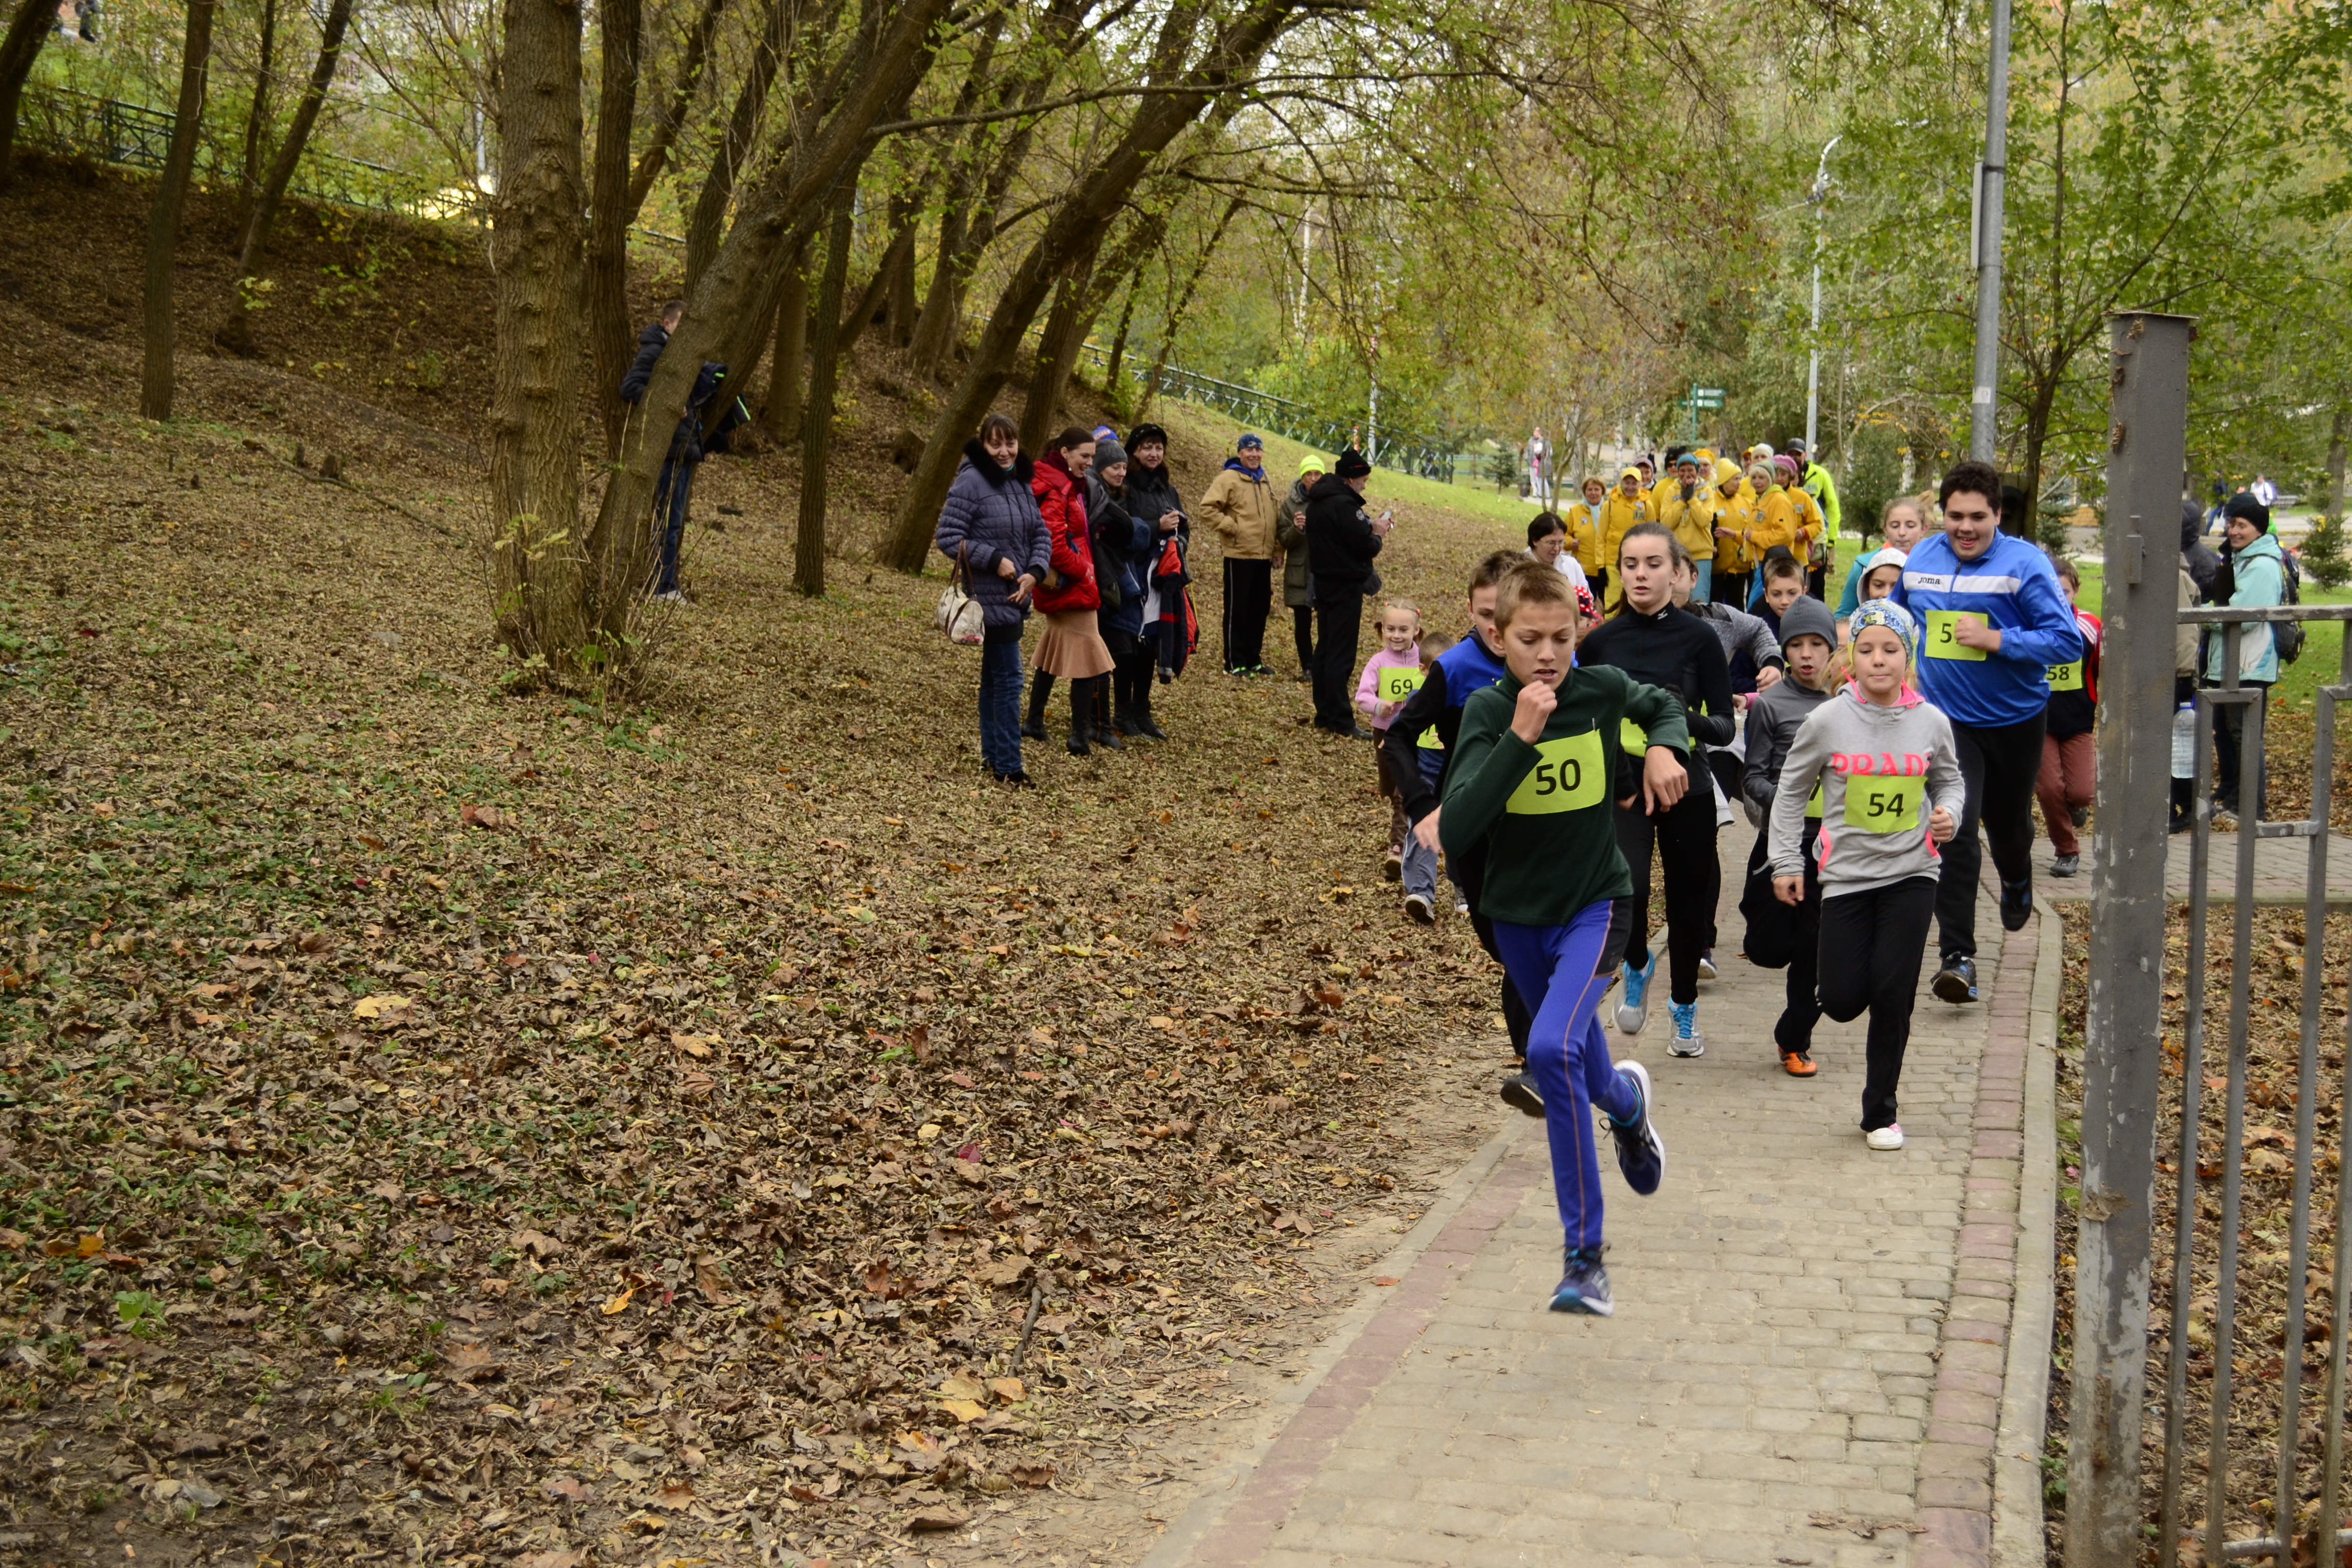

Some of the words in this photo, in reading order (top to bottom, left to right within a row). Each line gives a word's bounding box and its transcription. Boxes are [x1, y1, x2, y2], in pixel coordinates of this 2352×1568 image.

[1940, 623, 1958, 644] 5
[2047, 666, 2069, 681] 58
[1391, 679, 1413, 695] 69
[1831, 752, 1930, 776] PRAD
[1535, 758, 1580, 796] 50
[1867, 793, 1904, 818] 54
